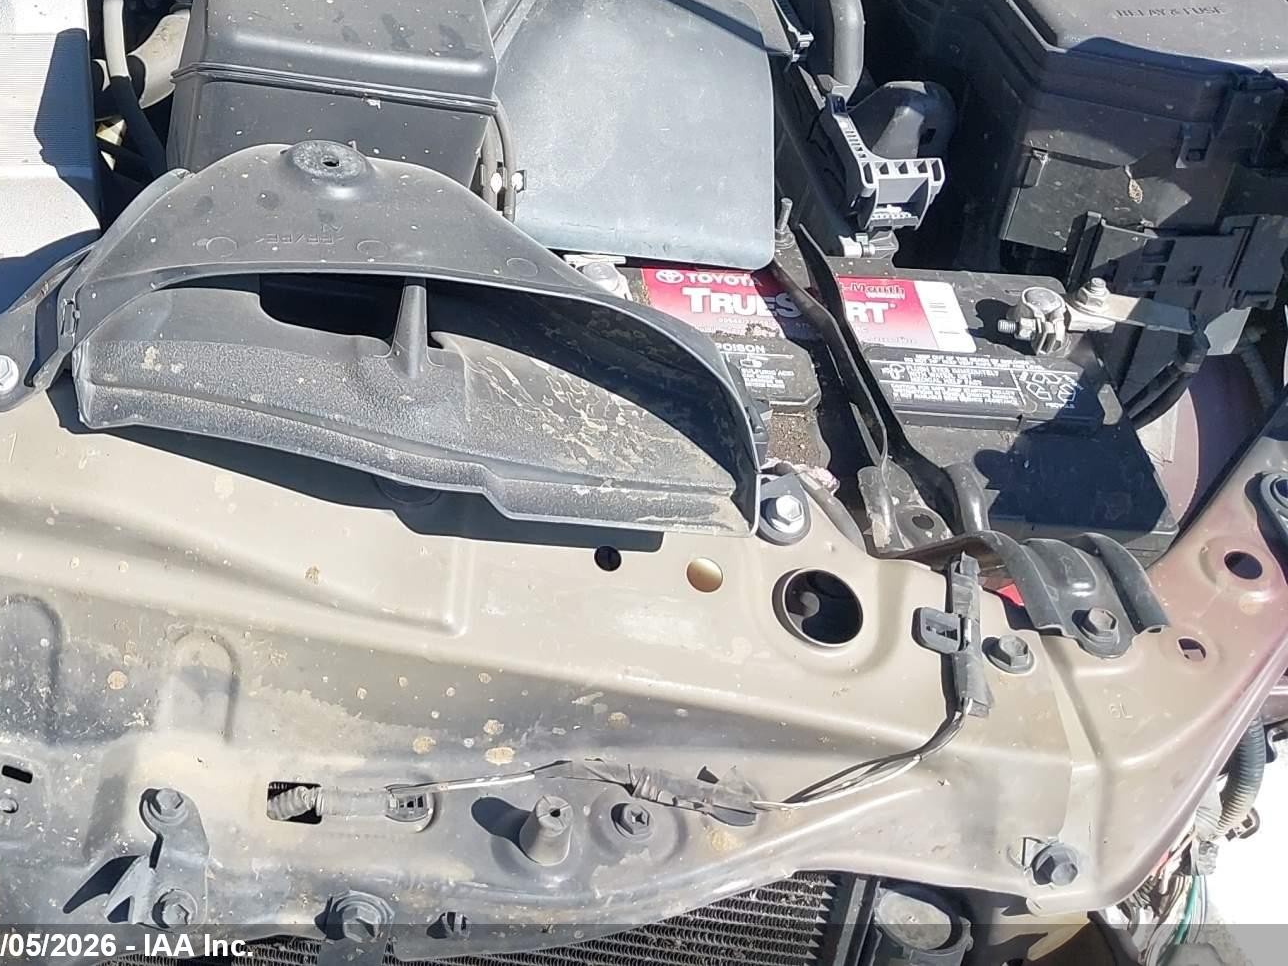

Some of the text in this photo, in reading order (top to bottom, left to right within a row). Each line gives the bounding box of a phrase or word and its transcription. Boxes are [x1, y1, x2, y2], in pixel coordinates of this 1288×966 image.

[1115, 8, 1165, 17] RELAY
[1181, 5, 1225, 16] FUSE
[686, 272, 764, 287] TOYOTA
[682, 287, 889, 324] TRUESRT
[715, 342, 766, 354] POISON
